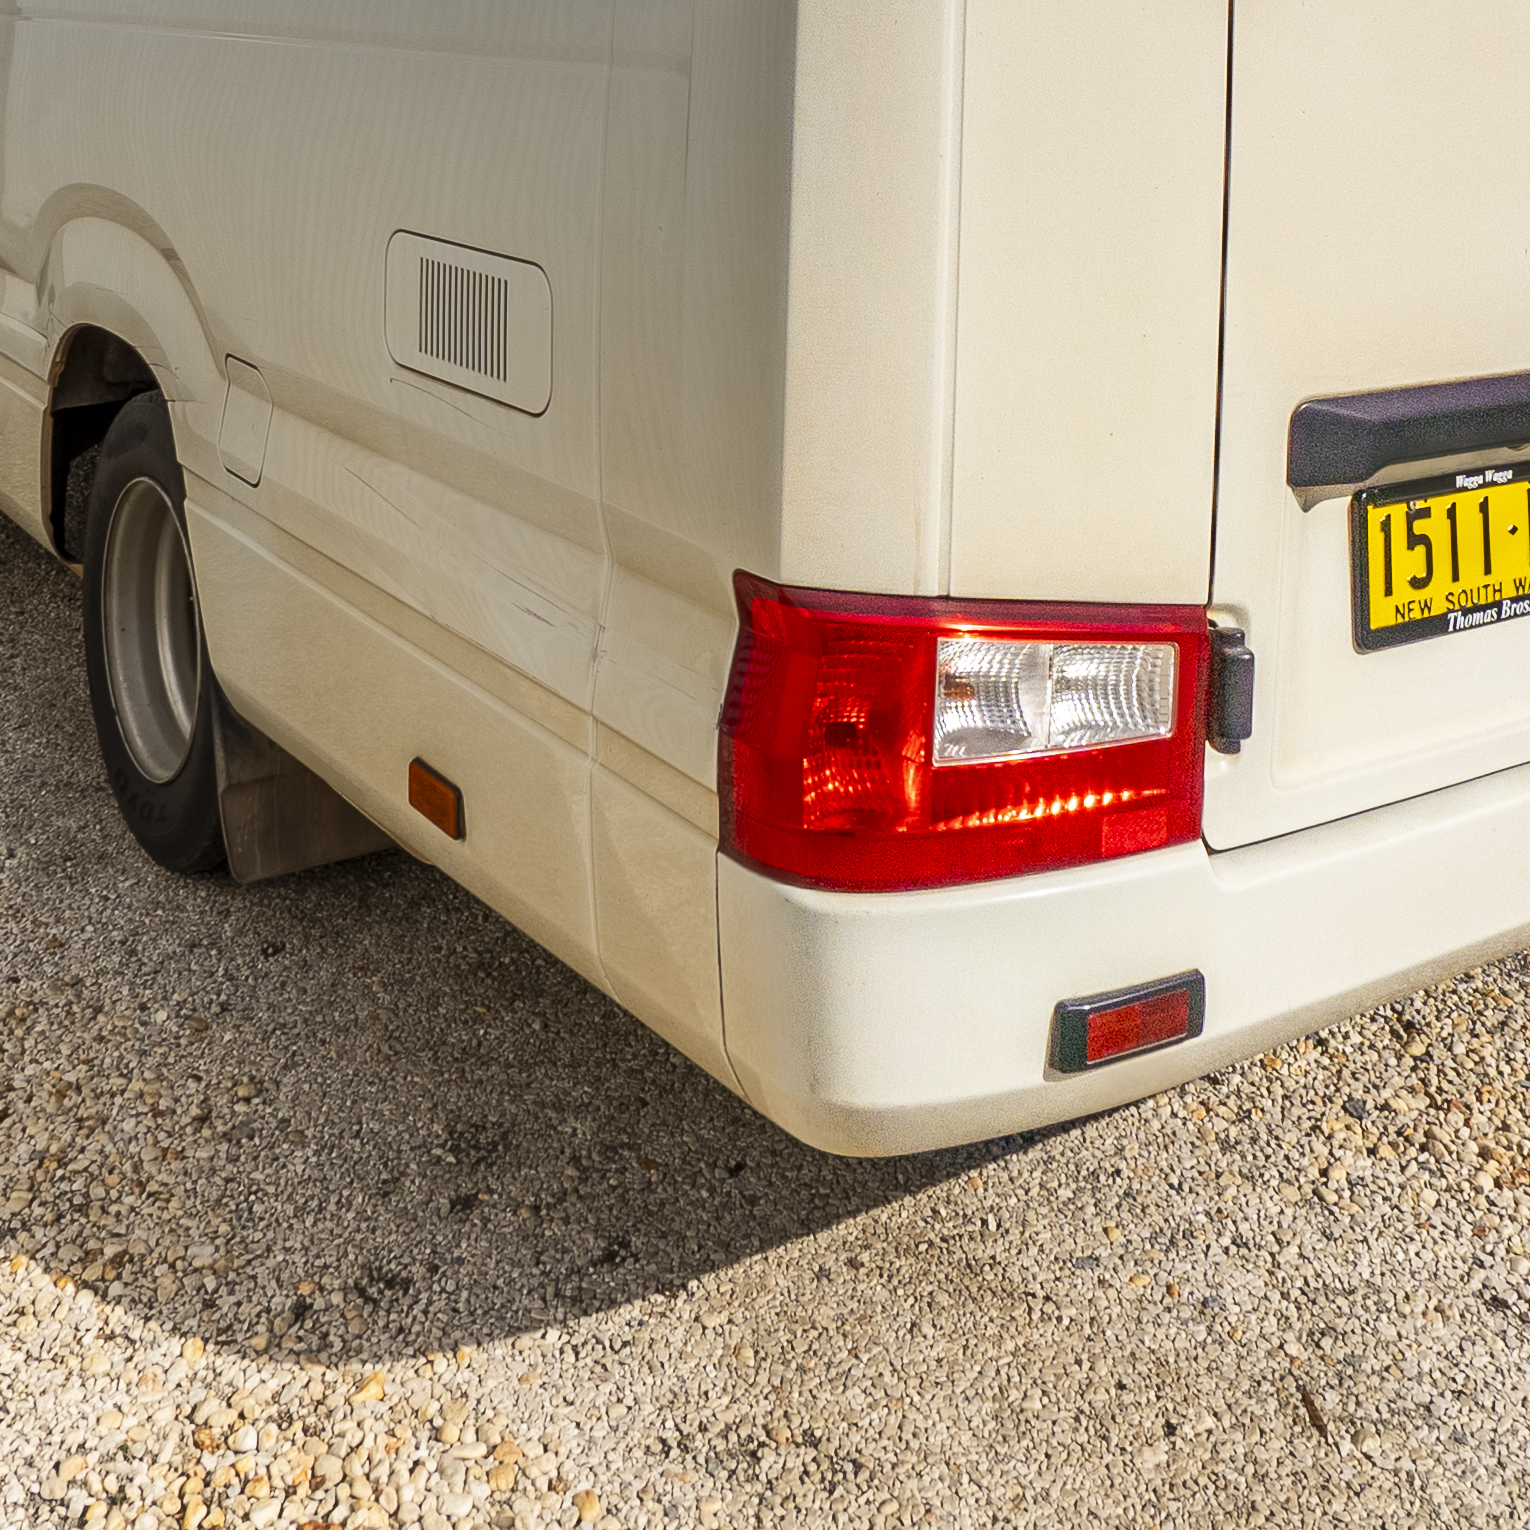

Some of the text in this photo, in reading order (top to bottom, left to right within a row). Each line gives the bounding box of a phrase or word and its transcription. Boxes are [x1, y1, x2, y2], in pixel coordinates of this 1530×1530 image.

[1395, 598, 1433, 622] NEW
[1445, 580, 1503, 612] SOUTH
[1447, 607, 1498, 632] Thomas
